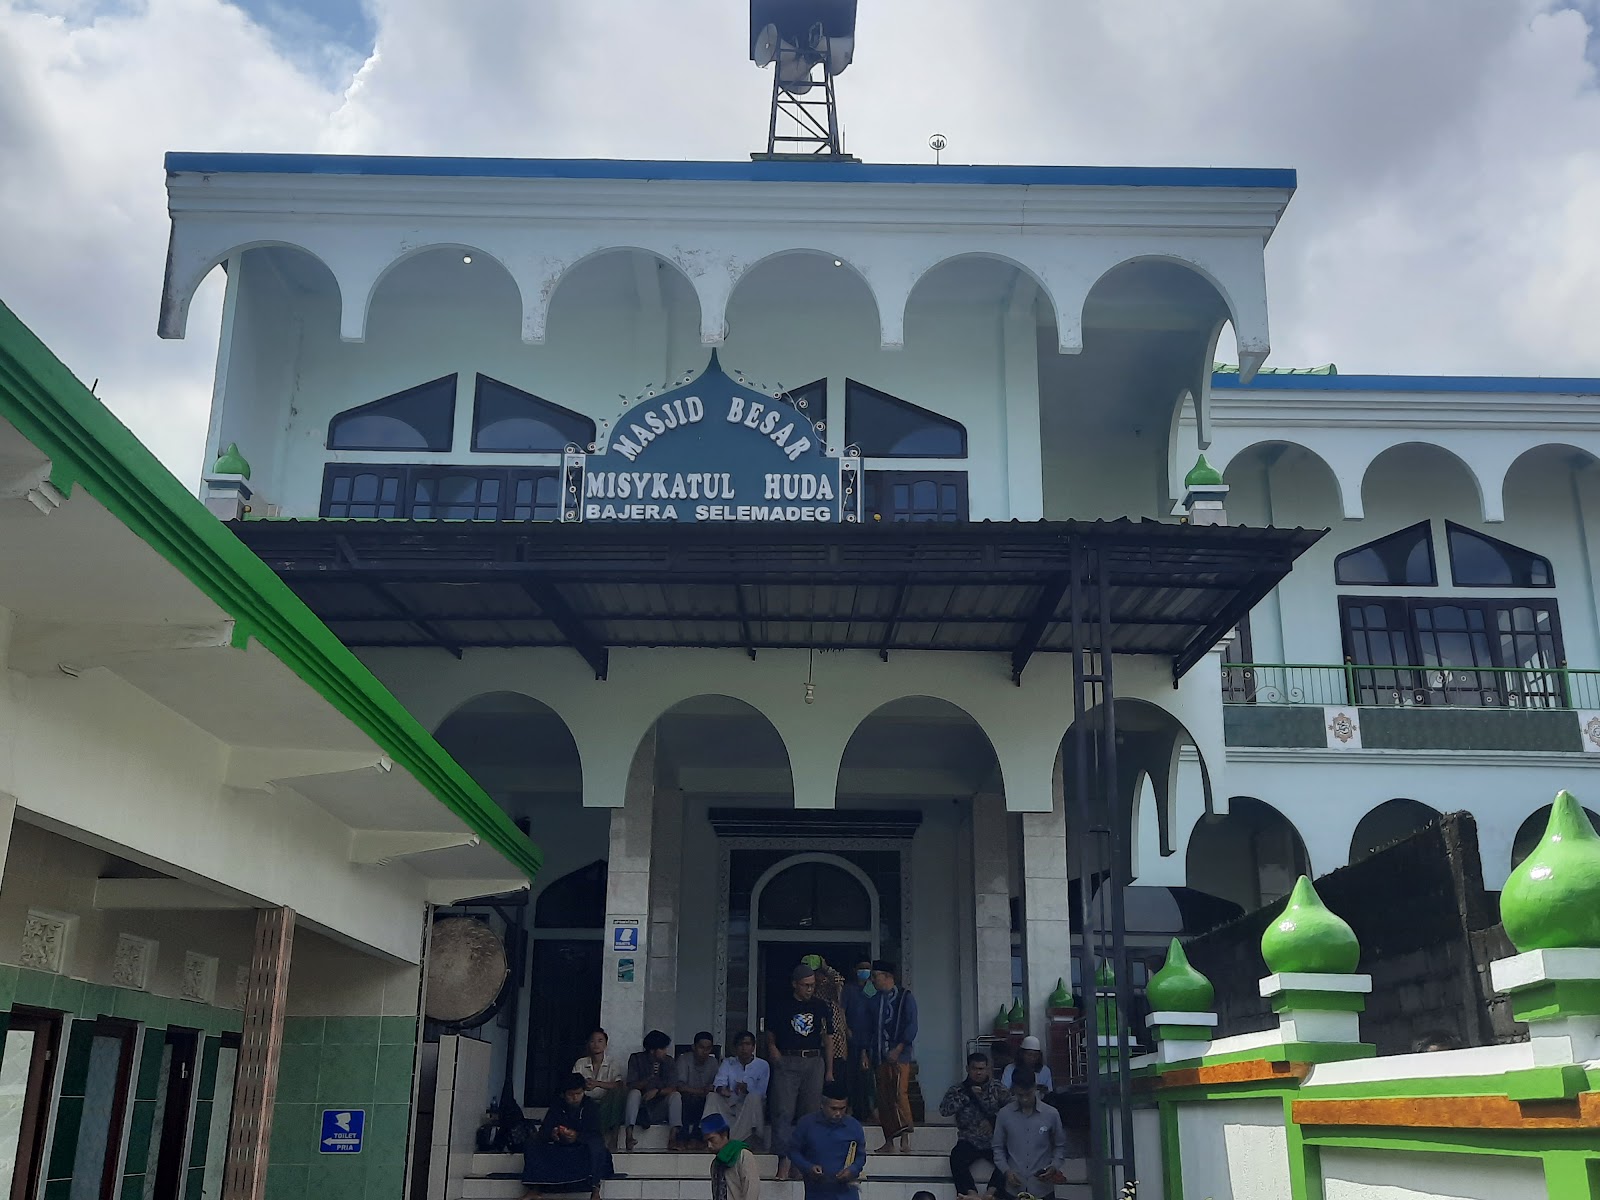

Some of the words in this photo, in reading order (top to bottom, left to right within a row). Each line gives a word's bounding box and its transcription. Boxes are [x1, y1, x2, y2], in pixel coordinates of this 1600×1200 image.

[612, 396, 704, 461] MASJID
[726, 397, 811, 461] BESAR
[586, 472, 735, 499] MISYKATUL
[764, 473, 834, 500] HUDA
[586, 504, 678, 519] BAJERA
[695, 505, 831, 521] SELEMADEG
